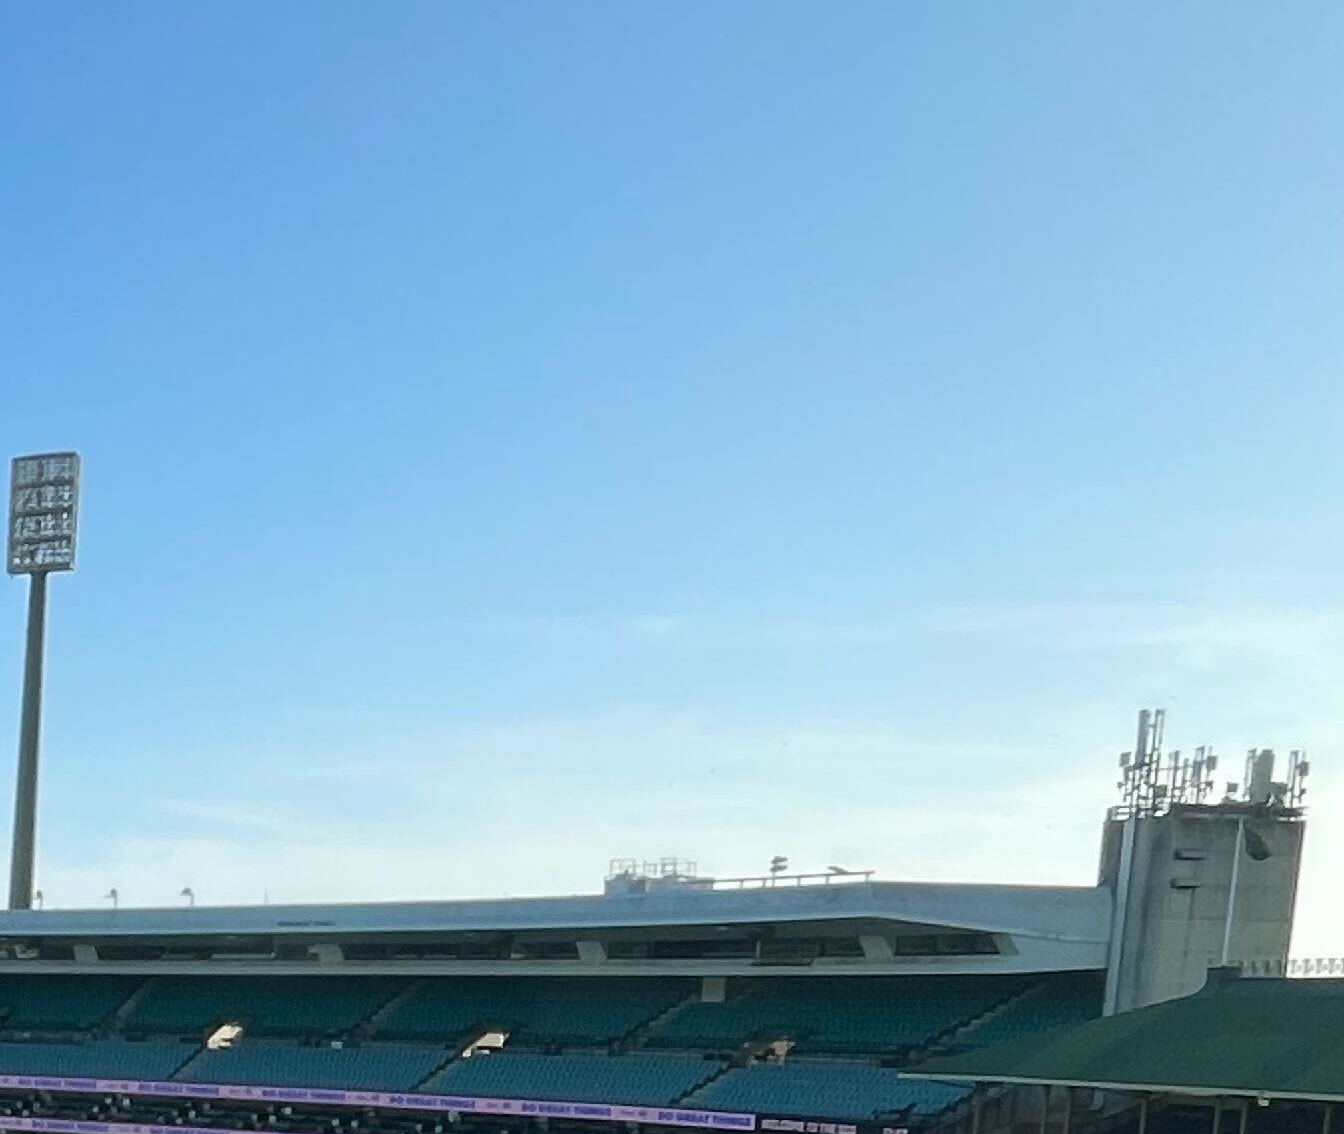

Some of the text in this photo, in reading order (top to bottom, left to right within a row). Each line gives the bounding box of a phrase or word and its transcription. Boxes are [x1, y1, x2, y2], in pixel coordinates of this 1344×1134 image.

[539, 1103, 570, 1116] GREAT
[659, 1110, 673, 1122] DO
[677, 1111, 709, 1125] GREAT
[713, 1114, 750, 1128] THINGS
